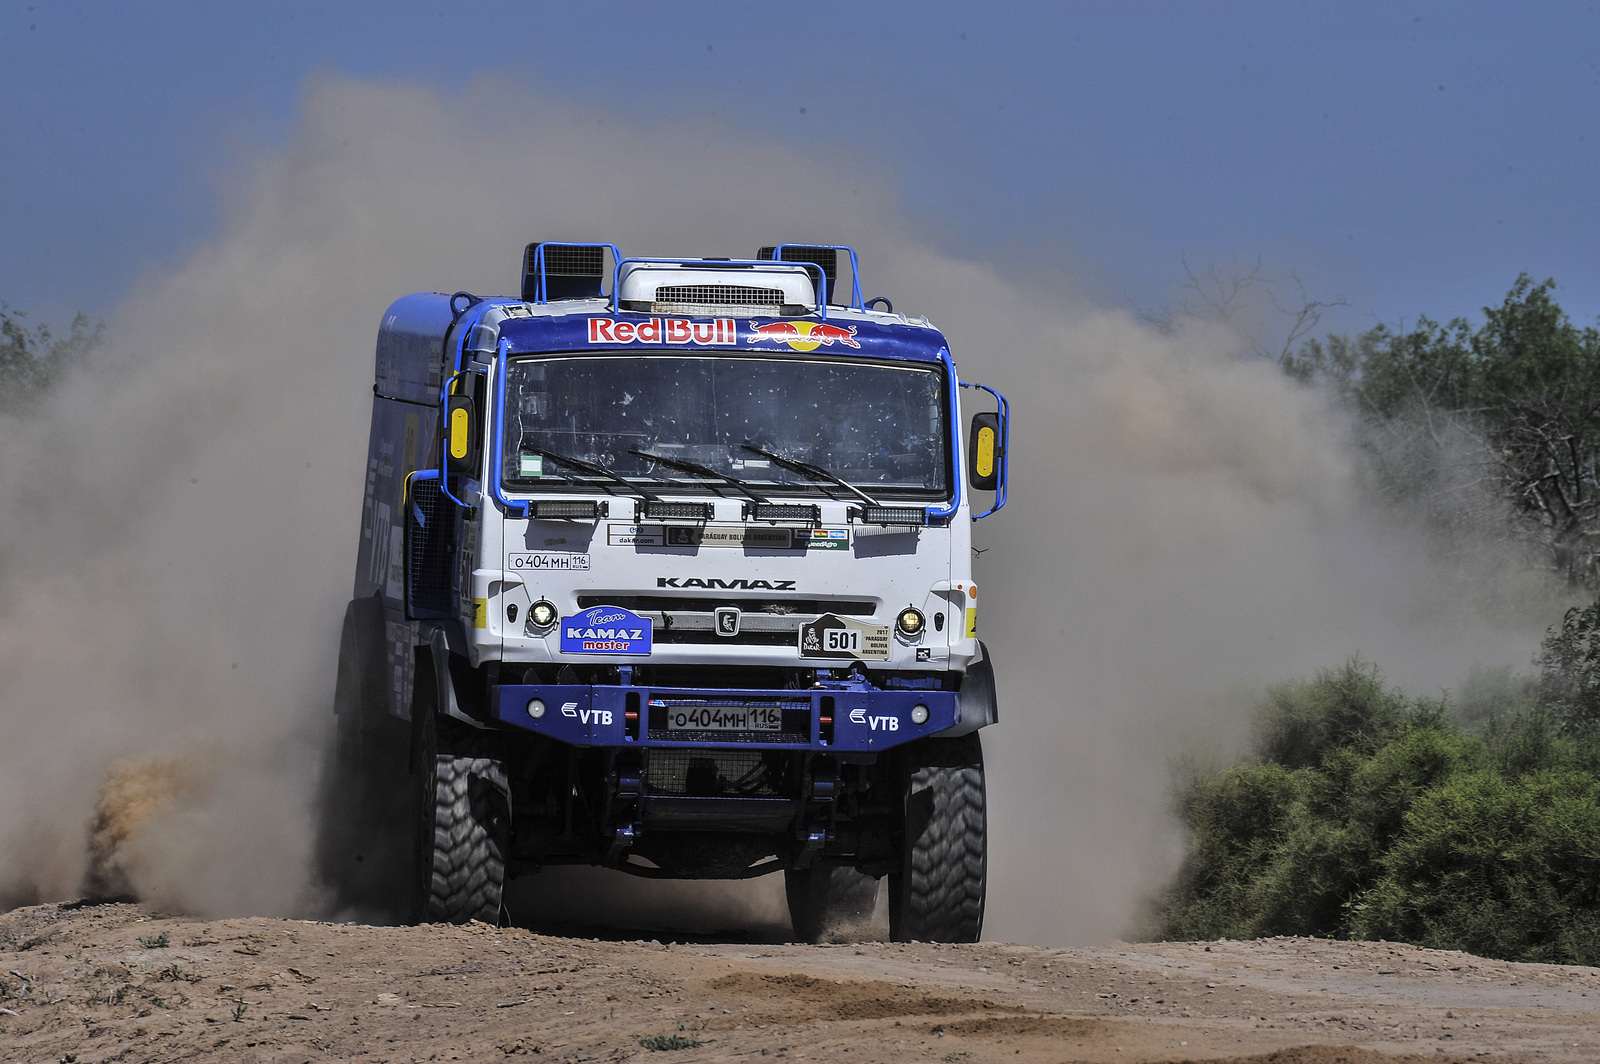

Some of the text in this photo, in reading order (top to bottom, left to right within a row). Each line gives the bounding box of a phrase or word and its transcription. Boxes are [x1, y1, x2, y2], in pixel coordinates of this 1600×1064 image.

[588, 317, 736, 345] Red Bull
[573, 556, 586, 565] 116
[657, 577, 796, 591] KAMAZ
[586, 609, 626, 627] Team
[567, 628, 643, 640] KAMAZ
[829, 631, 858, 650] 501
[583, 641, 630, 650] master
[579, 709, 613, 725] VTB
[749, 709, 776, 723] 116
[868, 715, 899, 731] VTB
